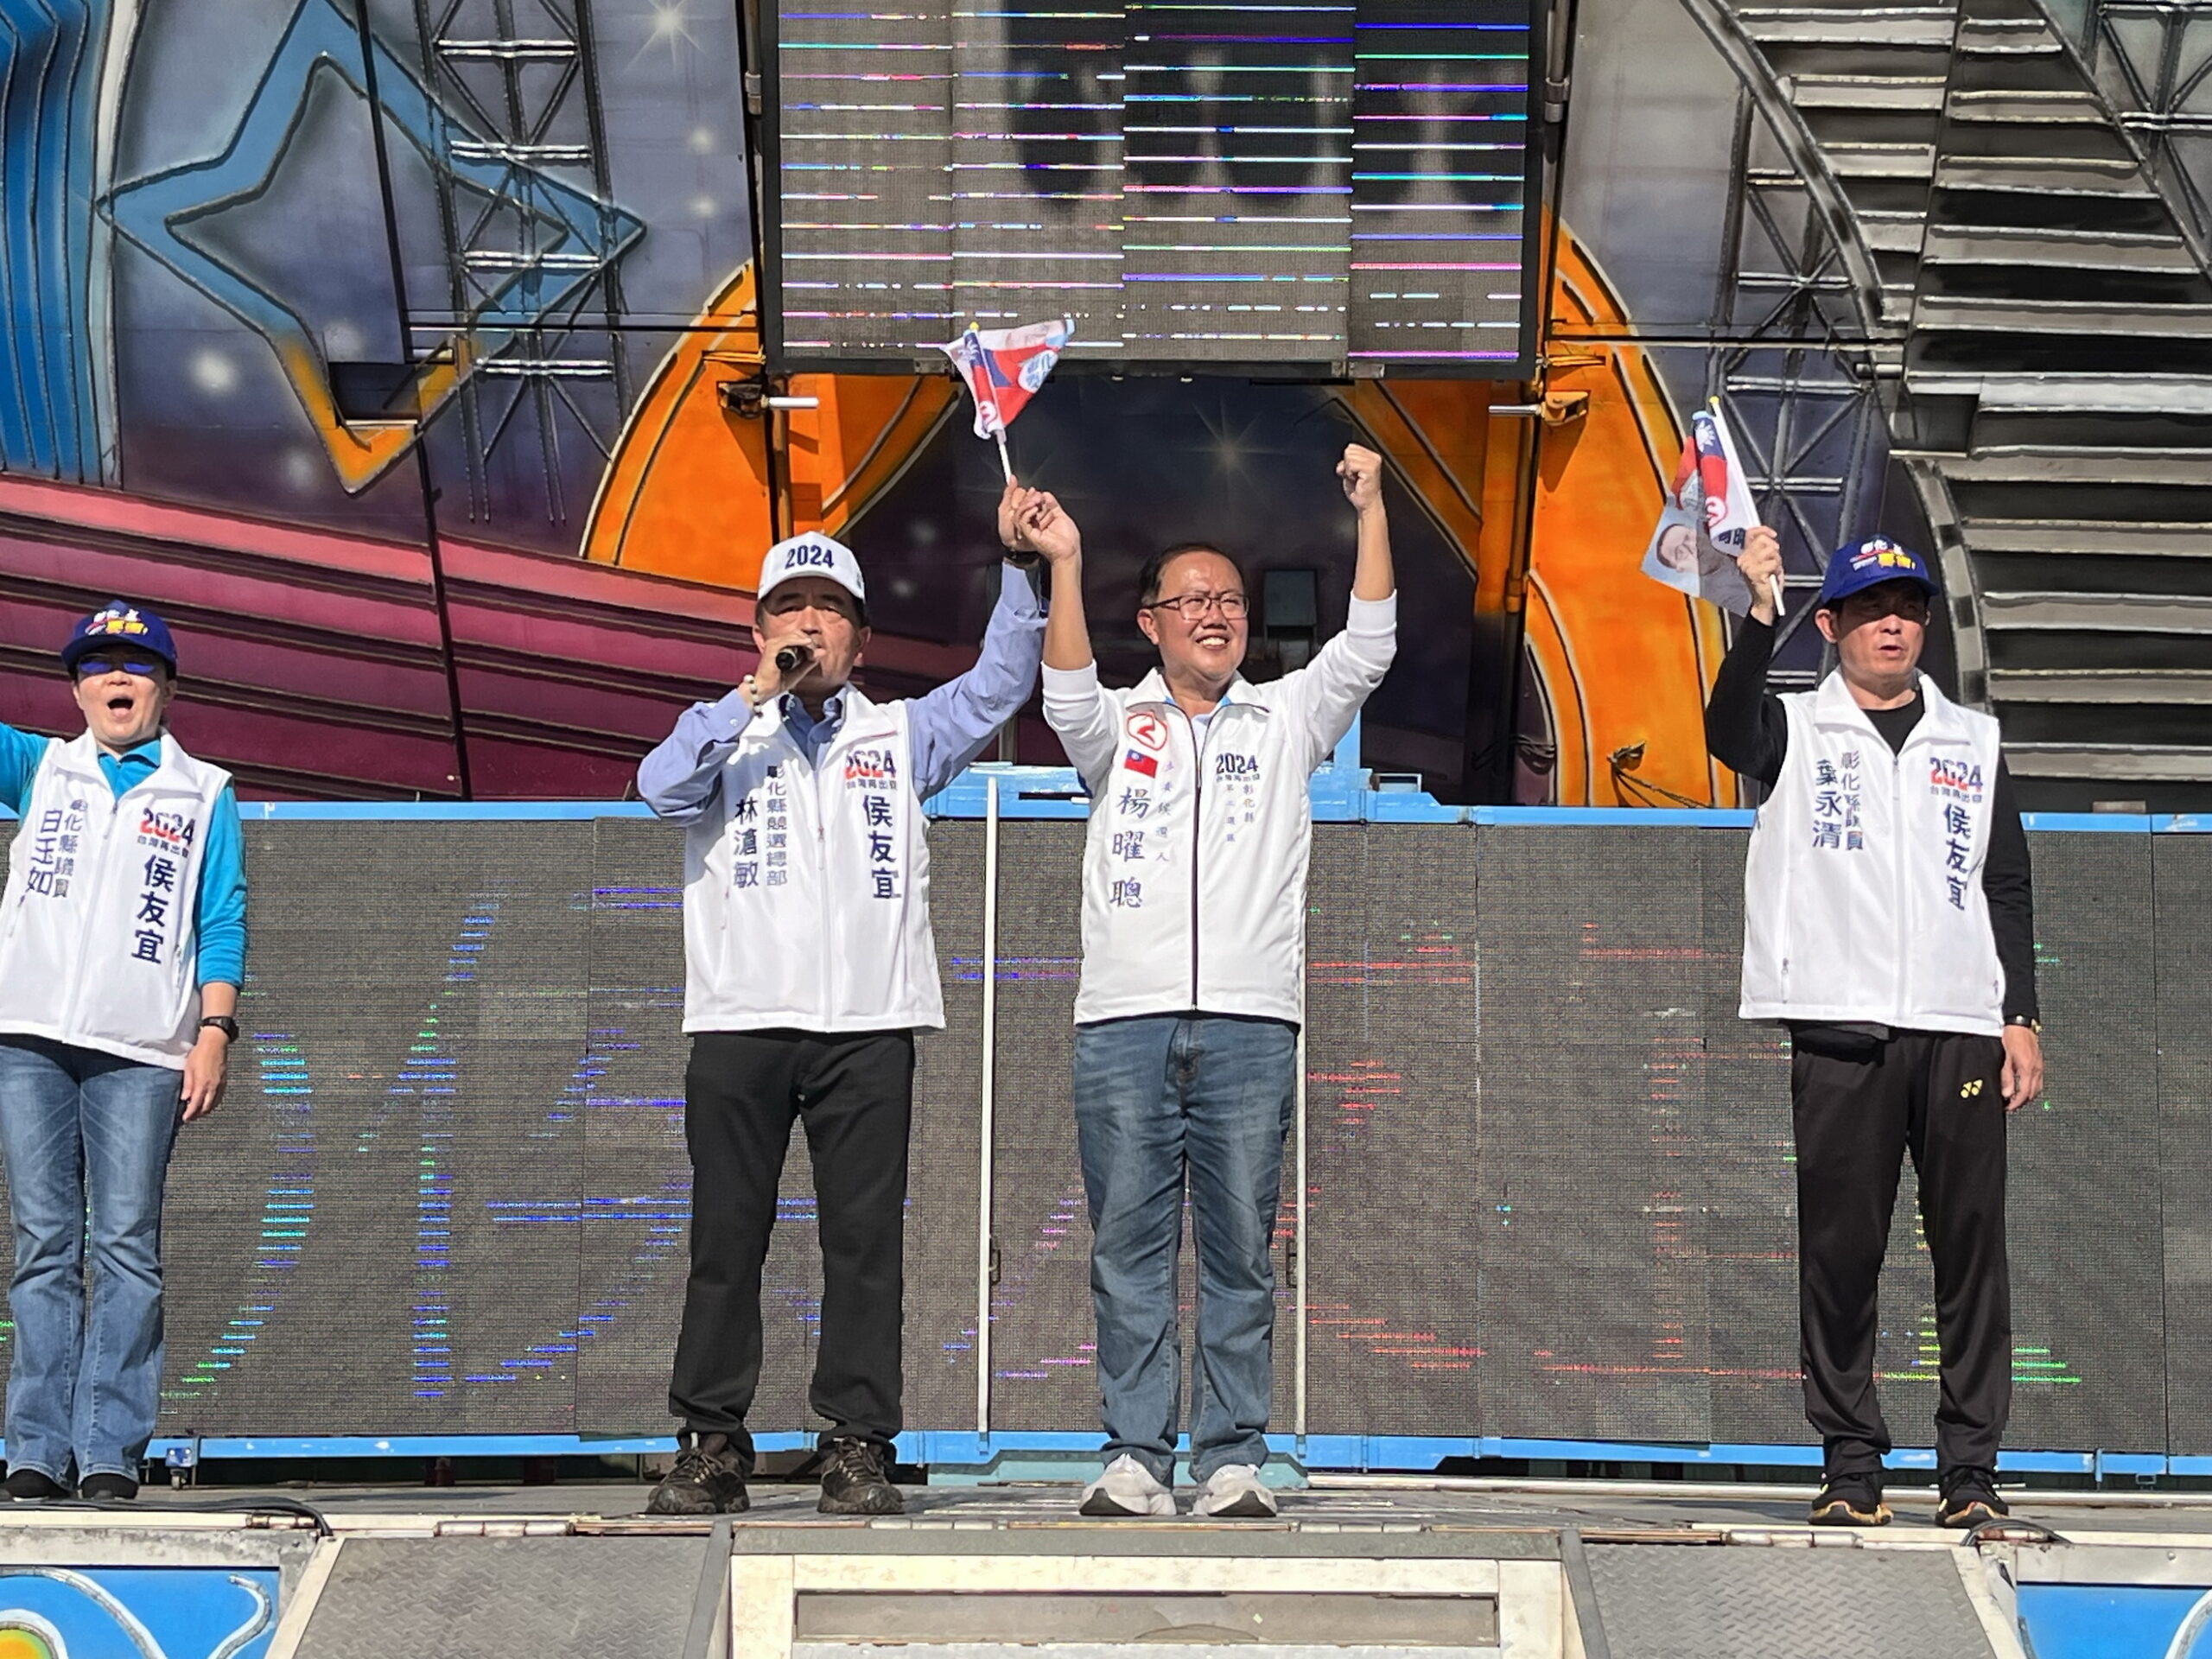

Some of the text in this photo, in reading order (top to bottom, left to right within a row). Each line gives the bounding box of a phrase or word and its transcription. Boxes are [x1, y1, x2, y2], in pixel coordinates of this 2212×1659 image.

[785, 545, 834, 569] 2024
[845, 750, 896, 779] 2024
[1216, 753, 1259, 773] 2024
[1929, 757, 1983, 791] 2024
[140, 808, 195, 846] 2024
[1812, 759, 1843, 849] 葉永清
[734, 797, 759, 888] 林滄敏
[863, 795, 901, 899] 侯友宜
[1943, 804, 1971, 911] 侯友宜
[131, 855, 176, 963] 侯友宜
